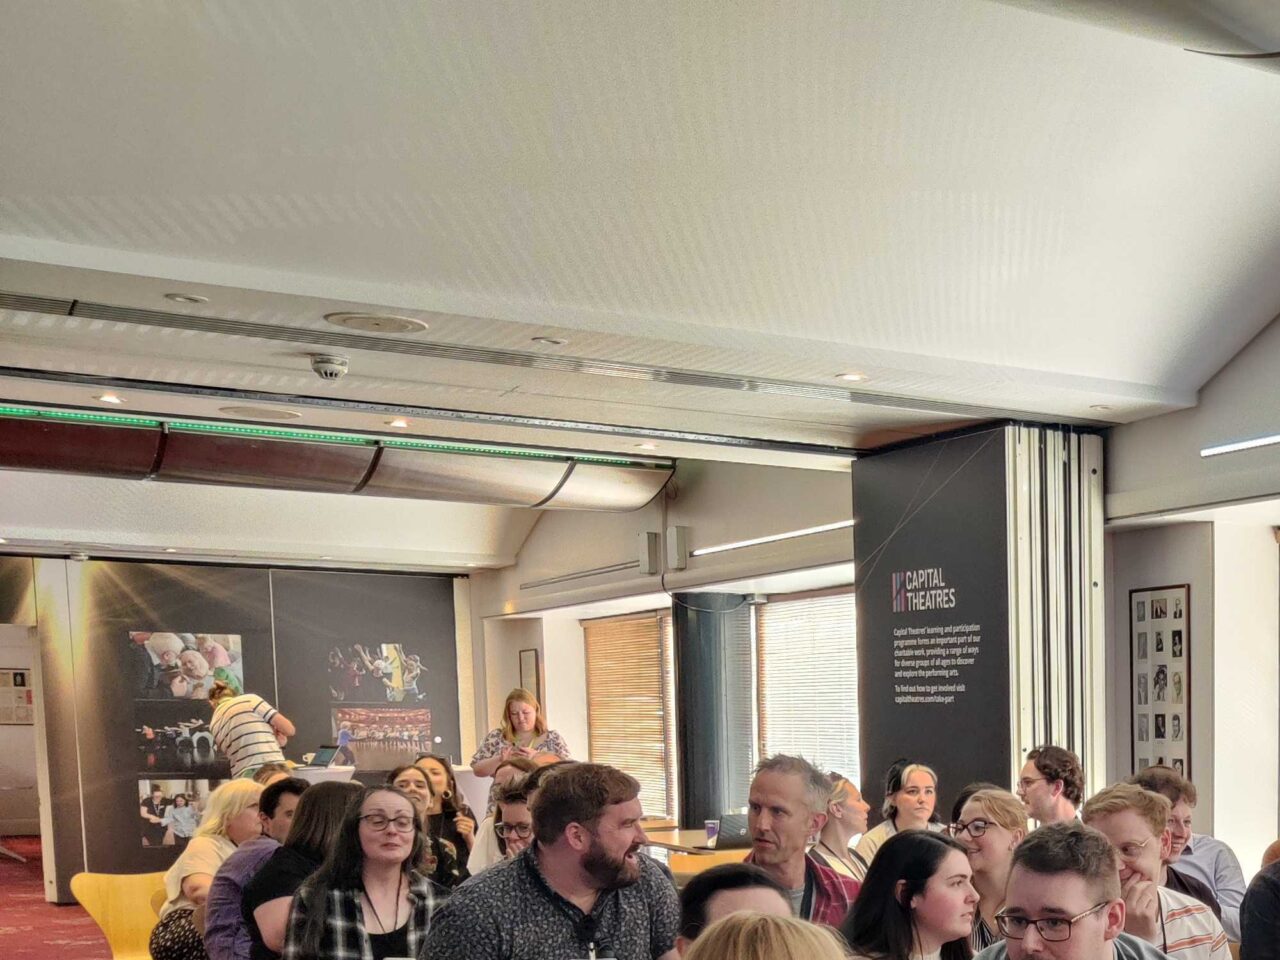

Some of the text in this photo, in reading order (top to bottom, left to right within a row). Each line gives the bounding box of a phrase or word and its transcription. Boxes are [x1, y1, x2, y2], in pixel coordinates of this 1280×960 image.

[906, 568, 946, 590] CAPITAL
[906, 588, 956, 611] THEATRES
[894, 628, 907, 637] Capital
[908, 627, 926, 636] Theatres'
[958, 636, 967, 645] part
[914, 648, 926, 656] work,
[950, 648, 961, 656] range
[968, 647, 979, 656] ways
[941, 659, 950, 668] ages
